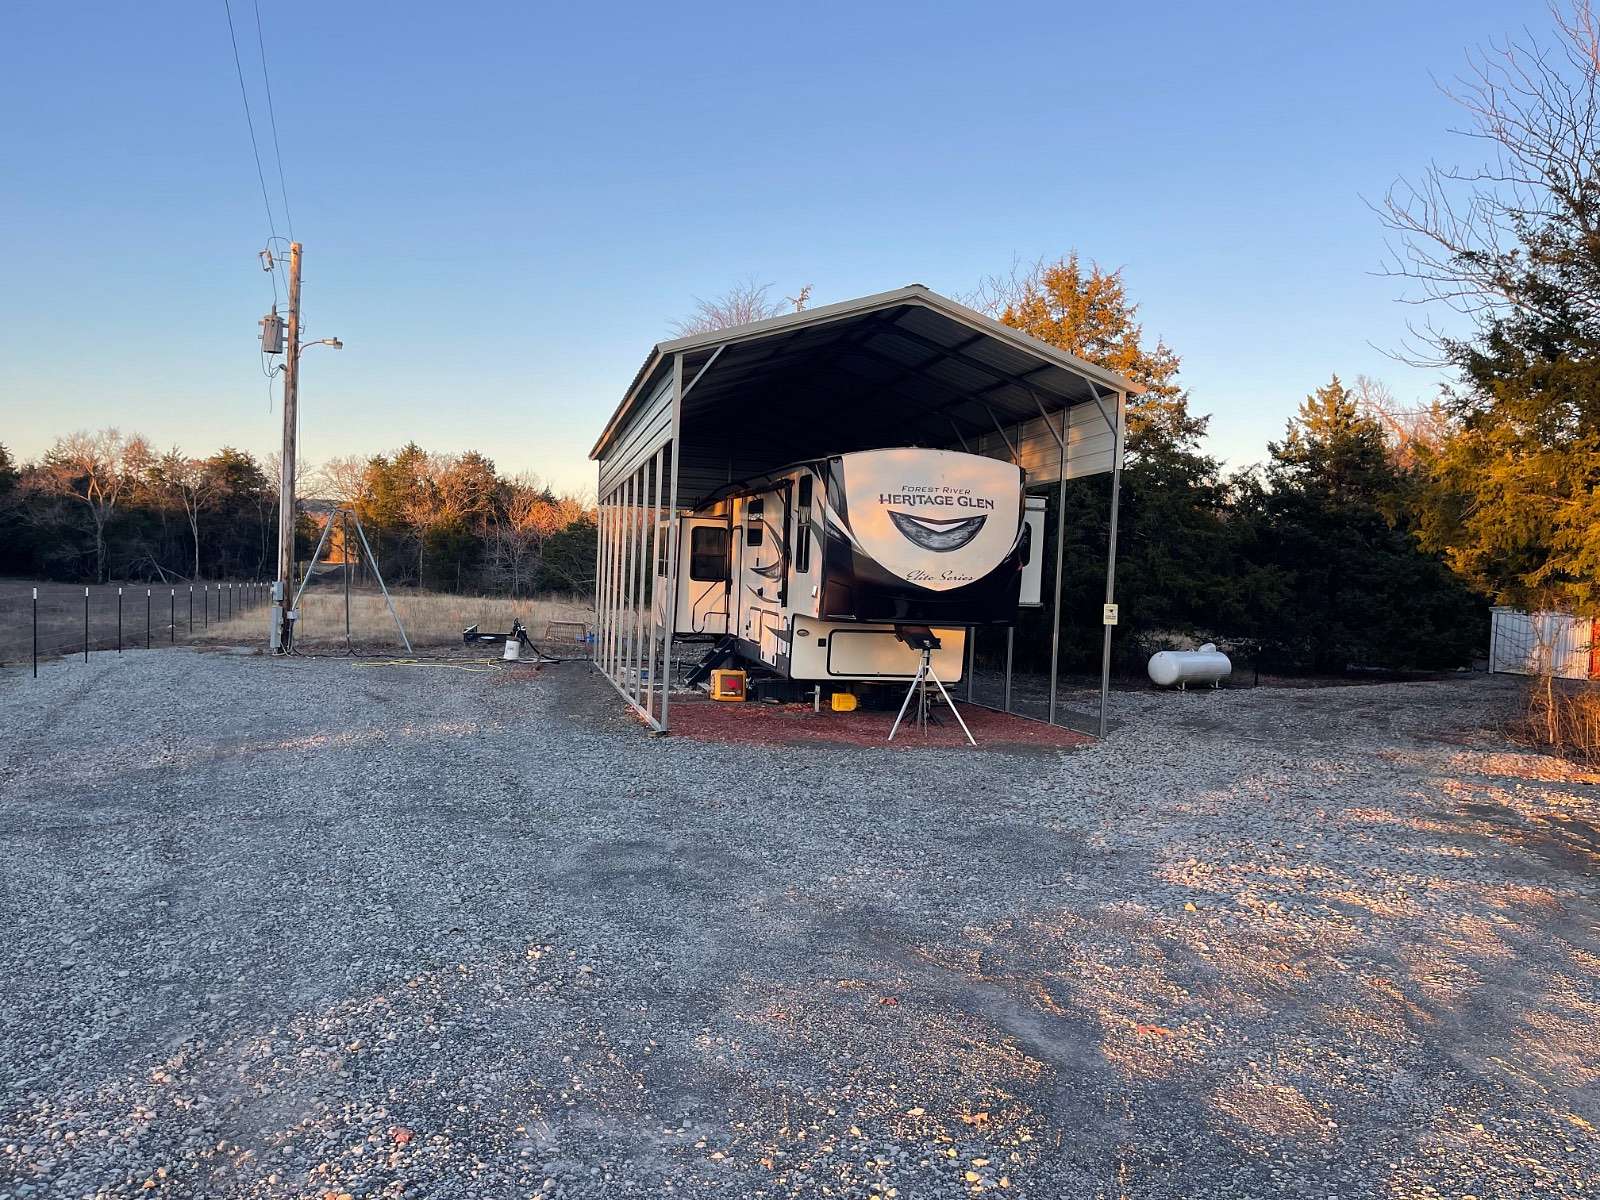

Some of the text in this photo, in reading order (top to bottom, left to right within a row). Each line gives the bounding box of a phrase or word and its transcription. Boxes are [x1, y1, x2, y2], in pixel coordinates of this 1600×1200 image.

[902, 485, 971, 495] FOREST RIVER
[879, 494, 994, 510] HERITAGE GLEN
[906, 569, 974, 582] Elite Series
